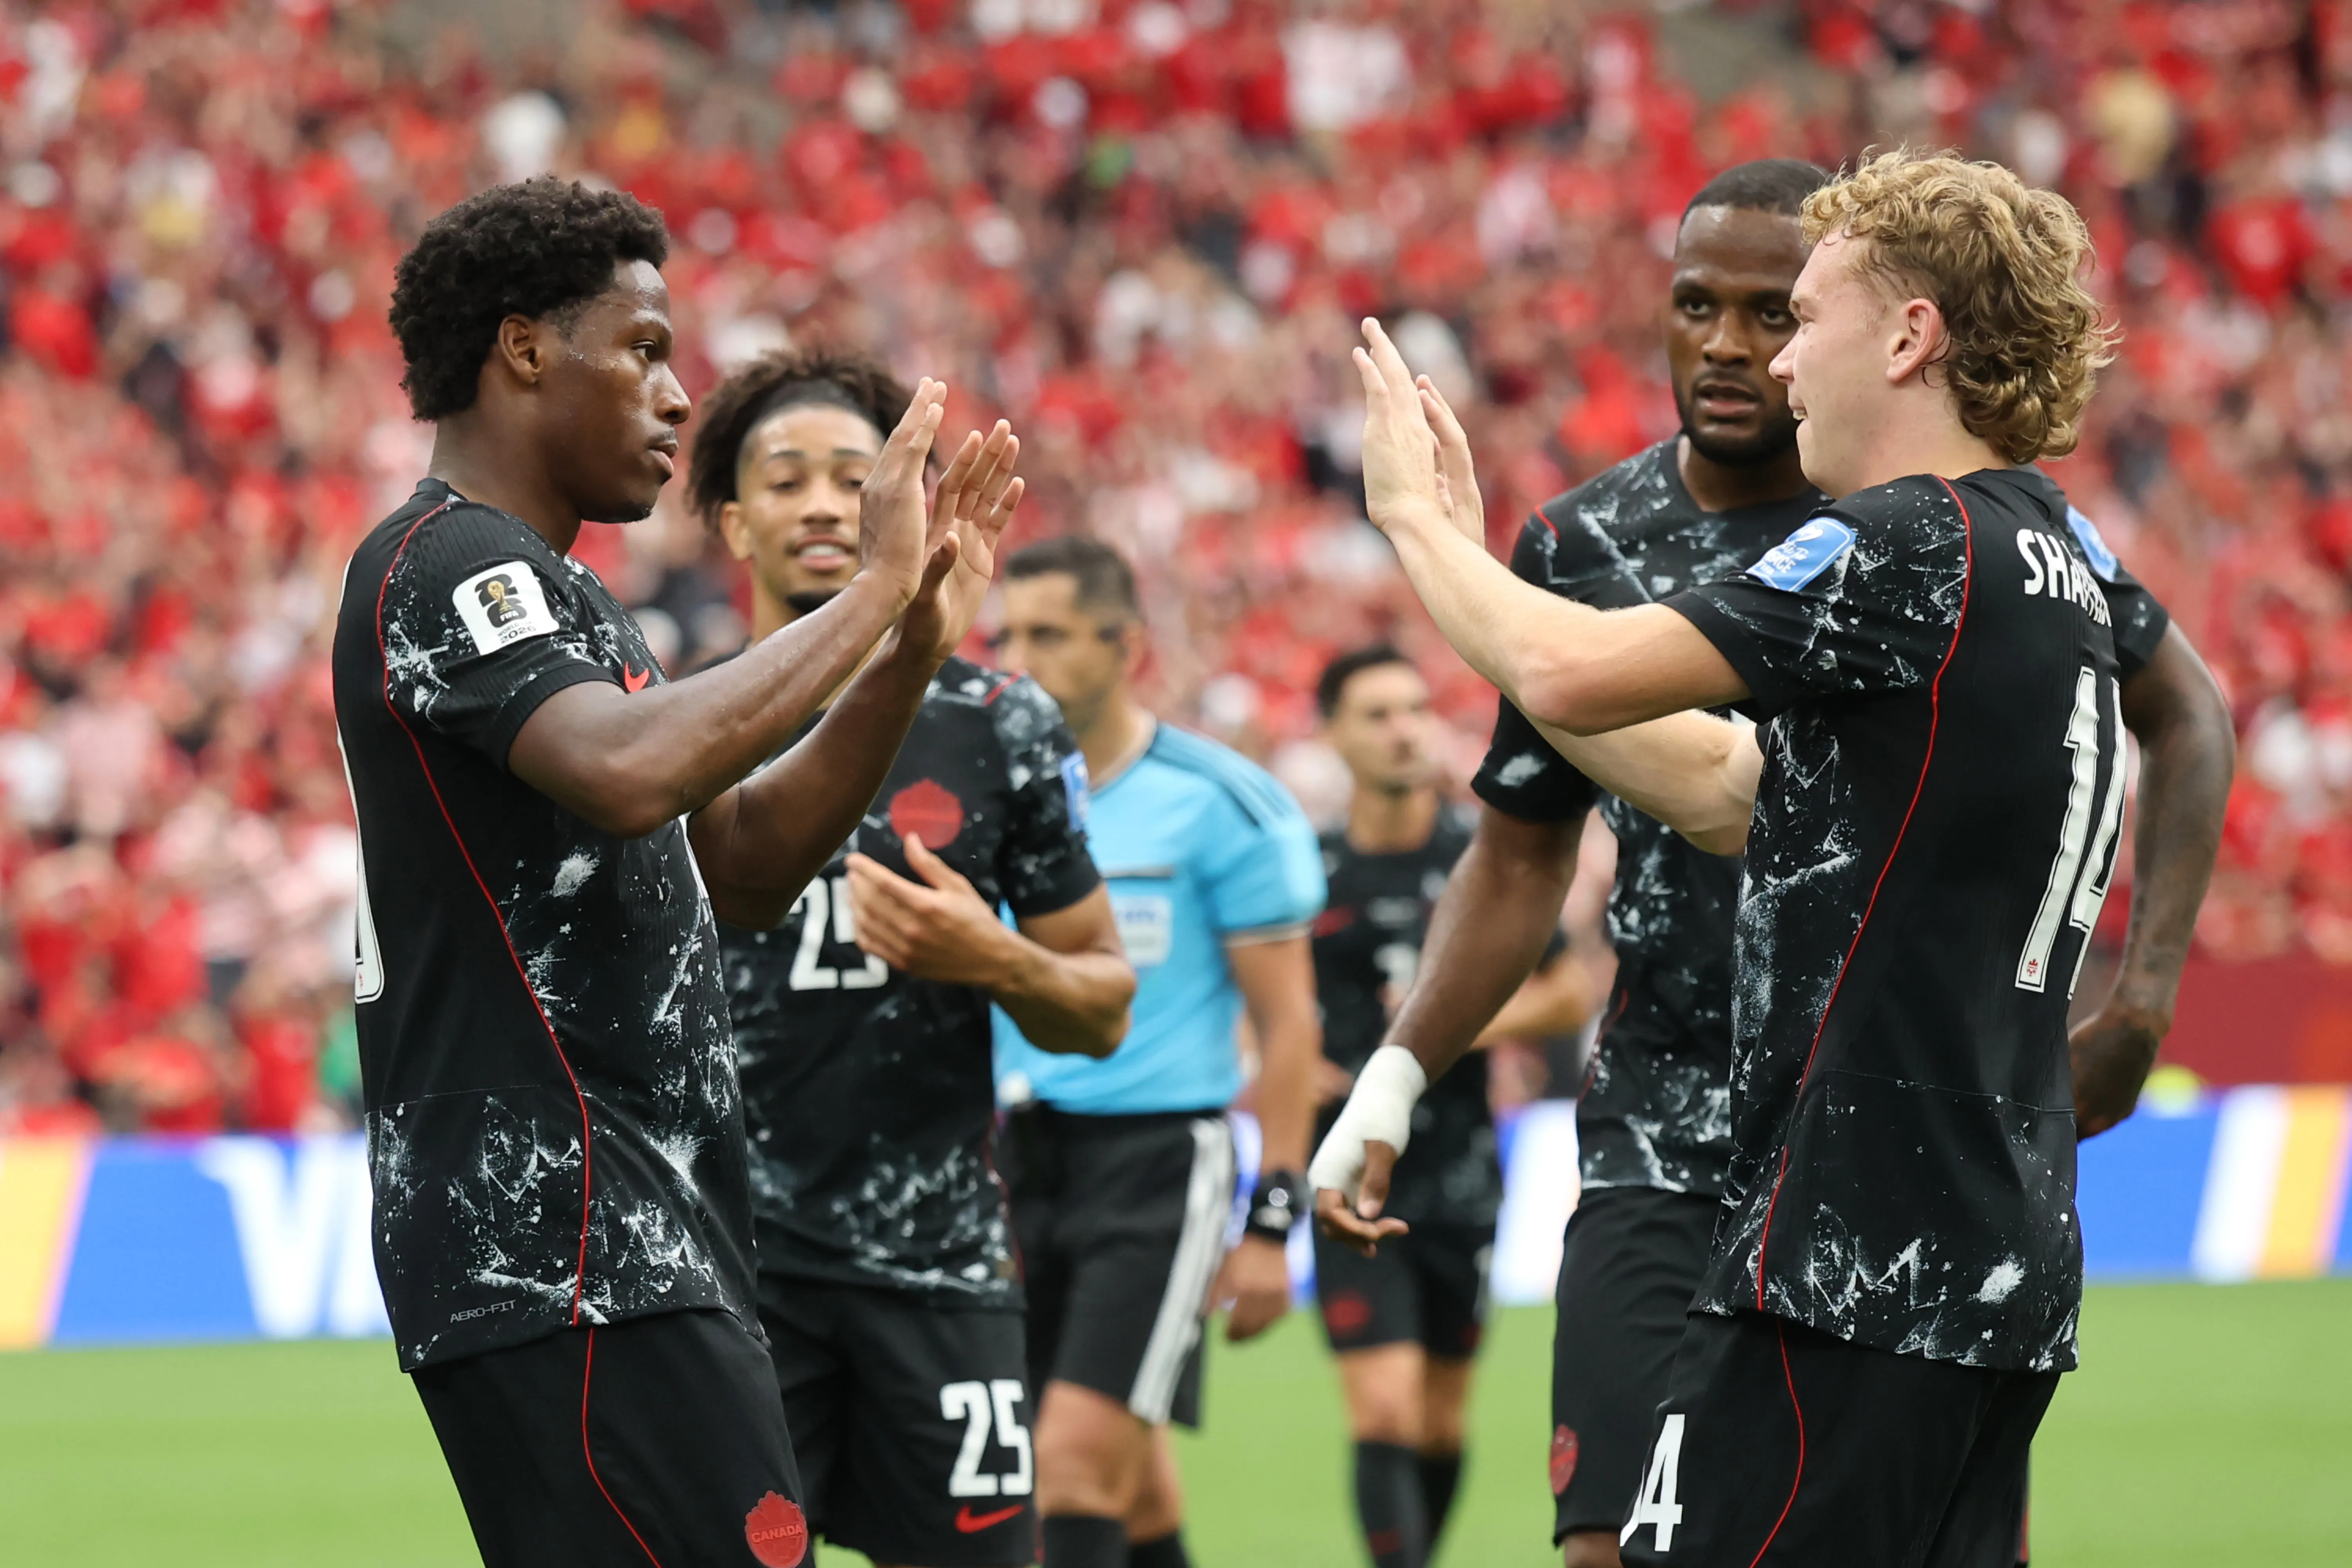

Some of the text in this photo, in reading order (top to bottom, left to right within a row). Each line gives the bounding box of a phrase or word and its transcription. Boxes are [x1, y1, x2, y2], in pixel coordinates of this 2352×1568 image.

[500, 610, 519, 621] FIFA
[497, 622, 519, 637] WORLD
[500, 626, 537, 644] 2026
[2015, 666, 2128, 1001] 14
[450, 1299, 516, 1323] AERO-FIT
[940, 1379, 1033, 1497] 25
[751, 1524, 802, 1543] CANADA
